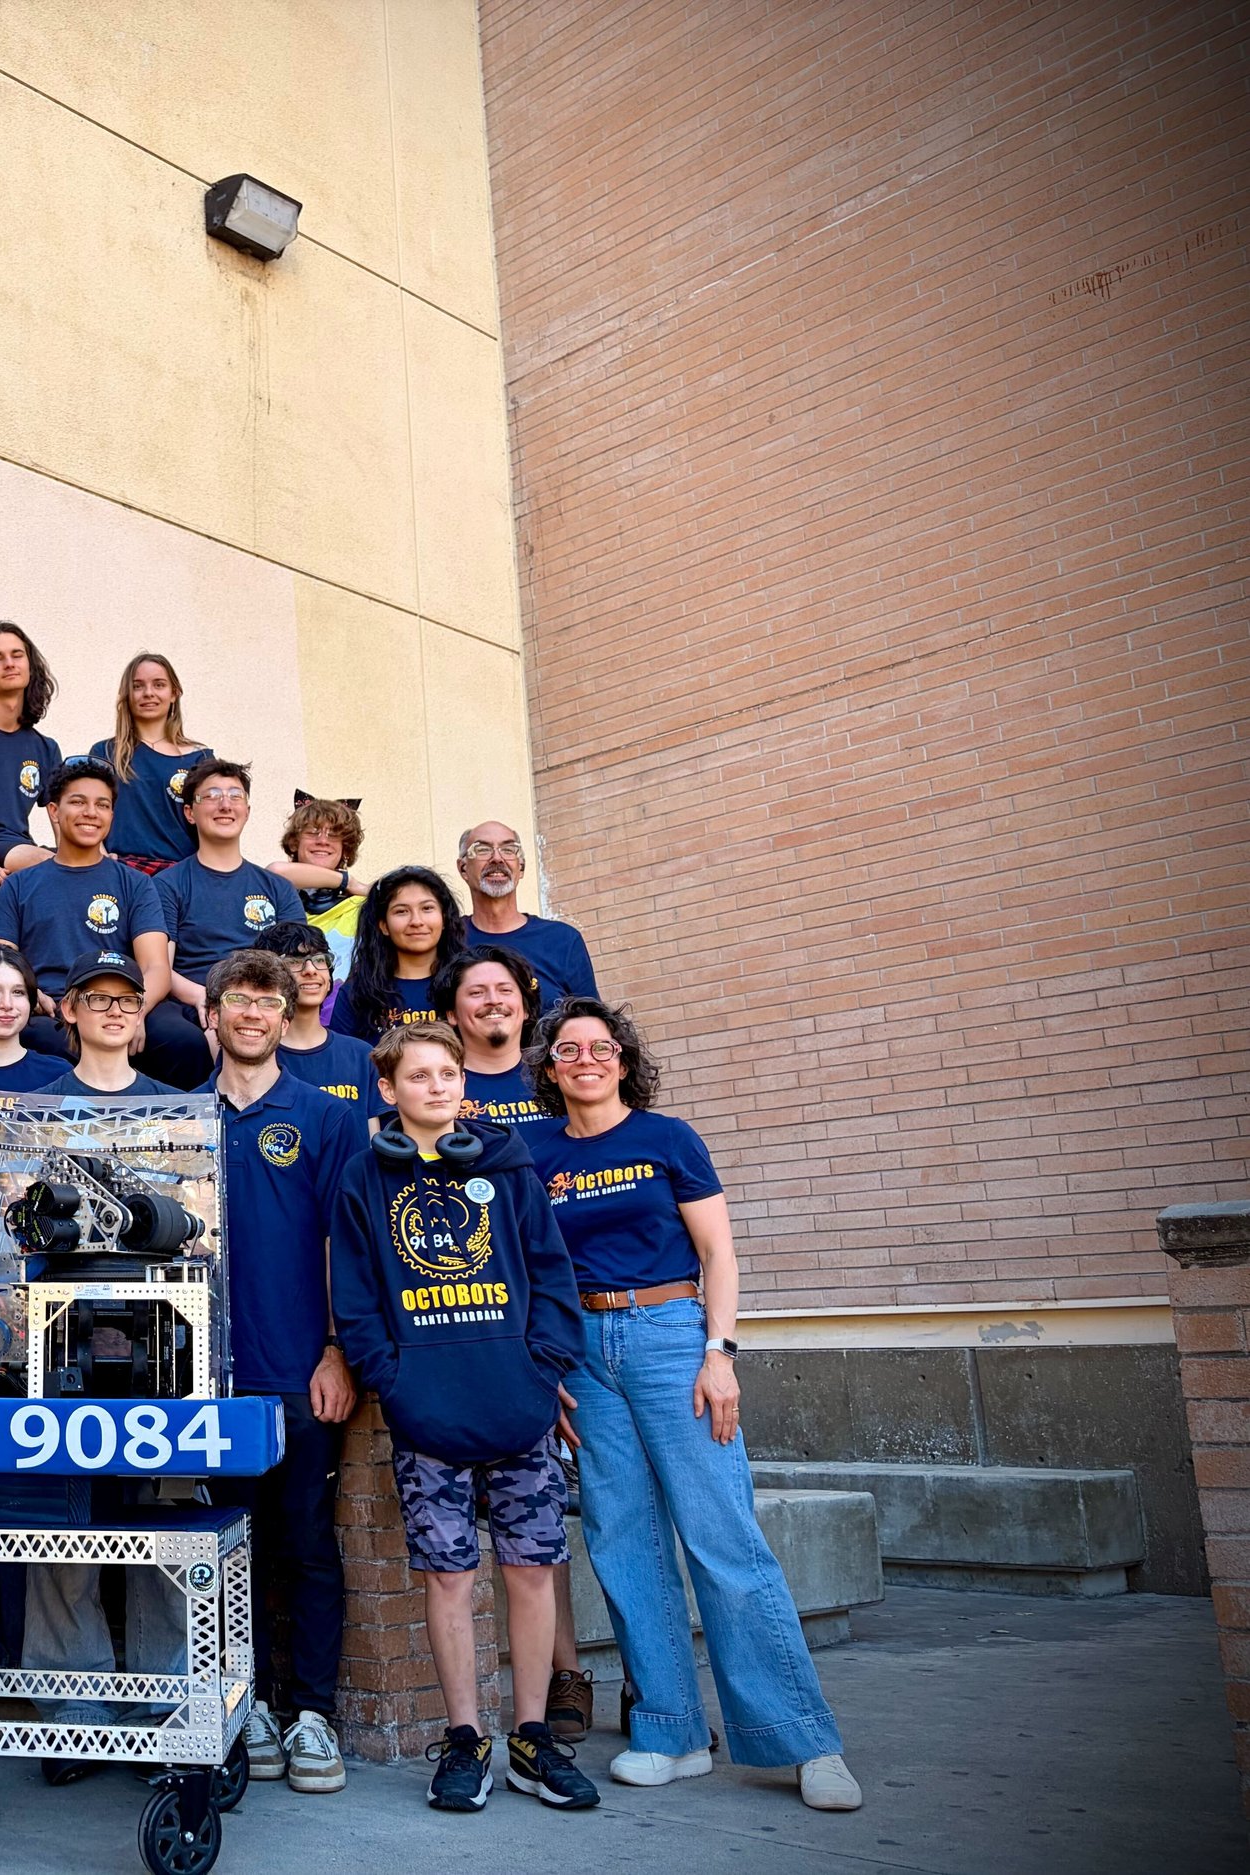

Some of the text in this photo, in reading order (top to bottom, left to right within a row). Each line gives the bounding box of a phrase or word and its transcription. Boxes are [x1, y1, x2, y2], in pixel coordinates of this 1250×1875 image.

[402, 1009, 436, 1024] OCTO
[575, 1164, 654, 1191] OCTOBOTS
[576, 1189, 600, 1200] SANTA
[401, 1282, 509, 1311] OCTOBOTS
[413, 1309, 505, 1327] SANTA BARBARA
[9, 1404, 232, 1469] 9084
